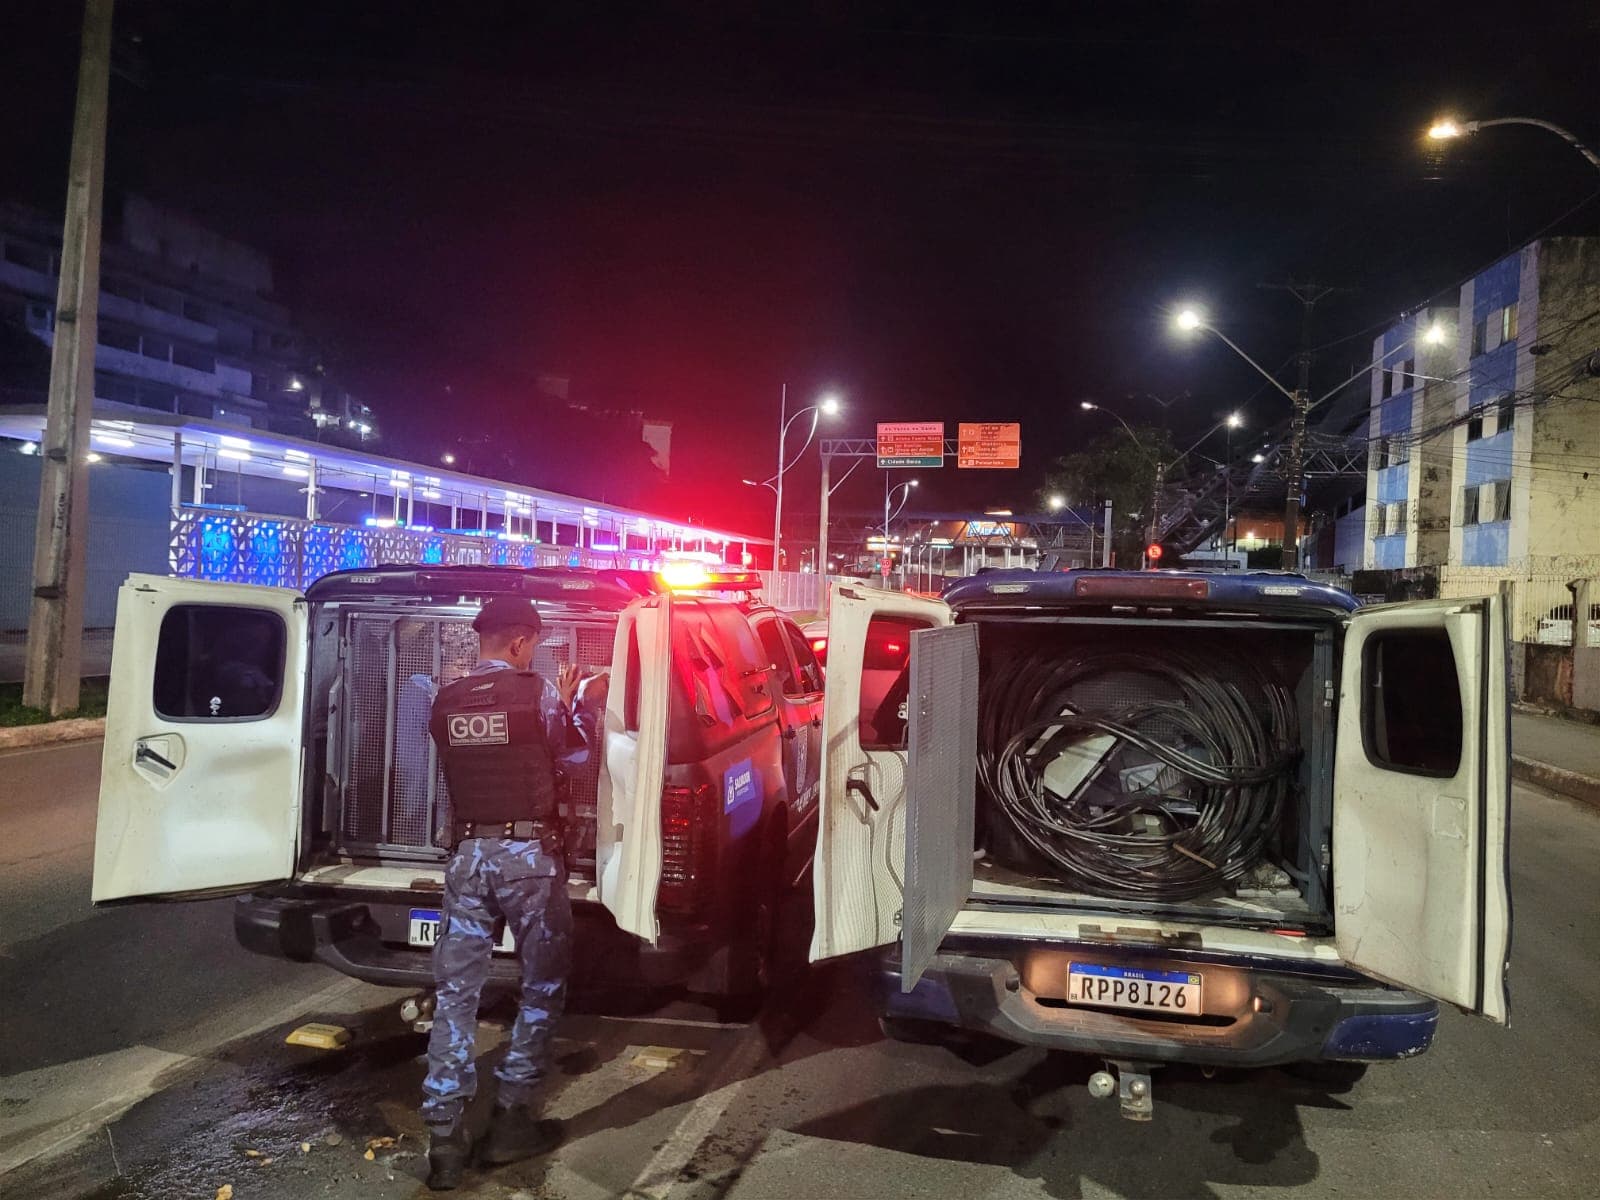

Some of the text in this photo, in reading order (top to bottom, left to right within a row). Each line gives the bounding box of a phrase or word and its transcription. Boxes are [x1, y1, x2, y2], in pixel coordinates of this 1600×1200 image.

[450, 714, 506, 739] GOE
[1123, 971, 1145, 979] BRASIL
[1081, 977, 1187, 1008] RPP8I26
